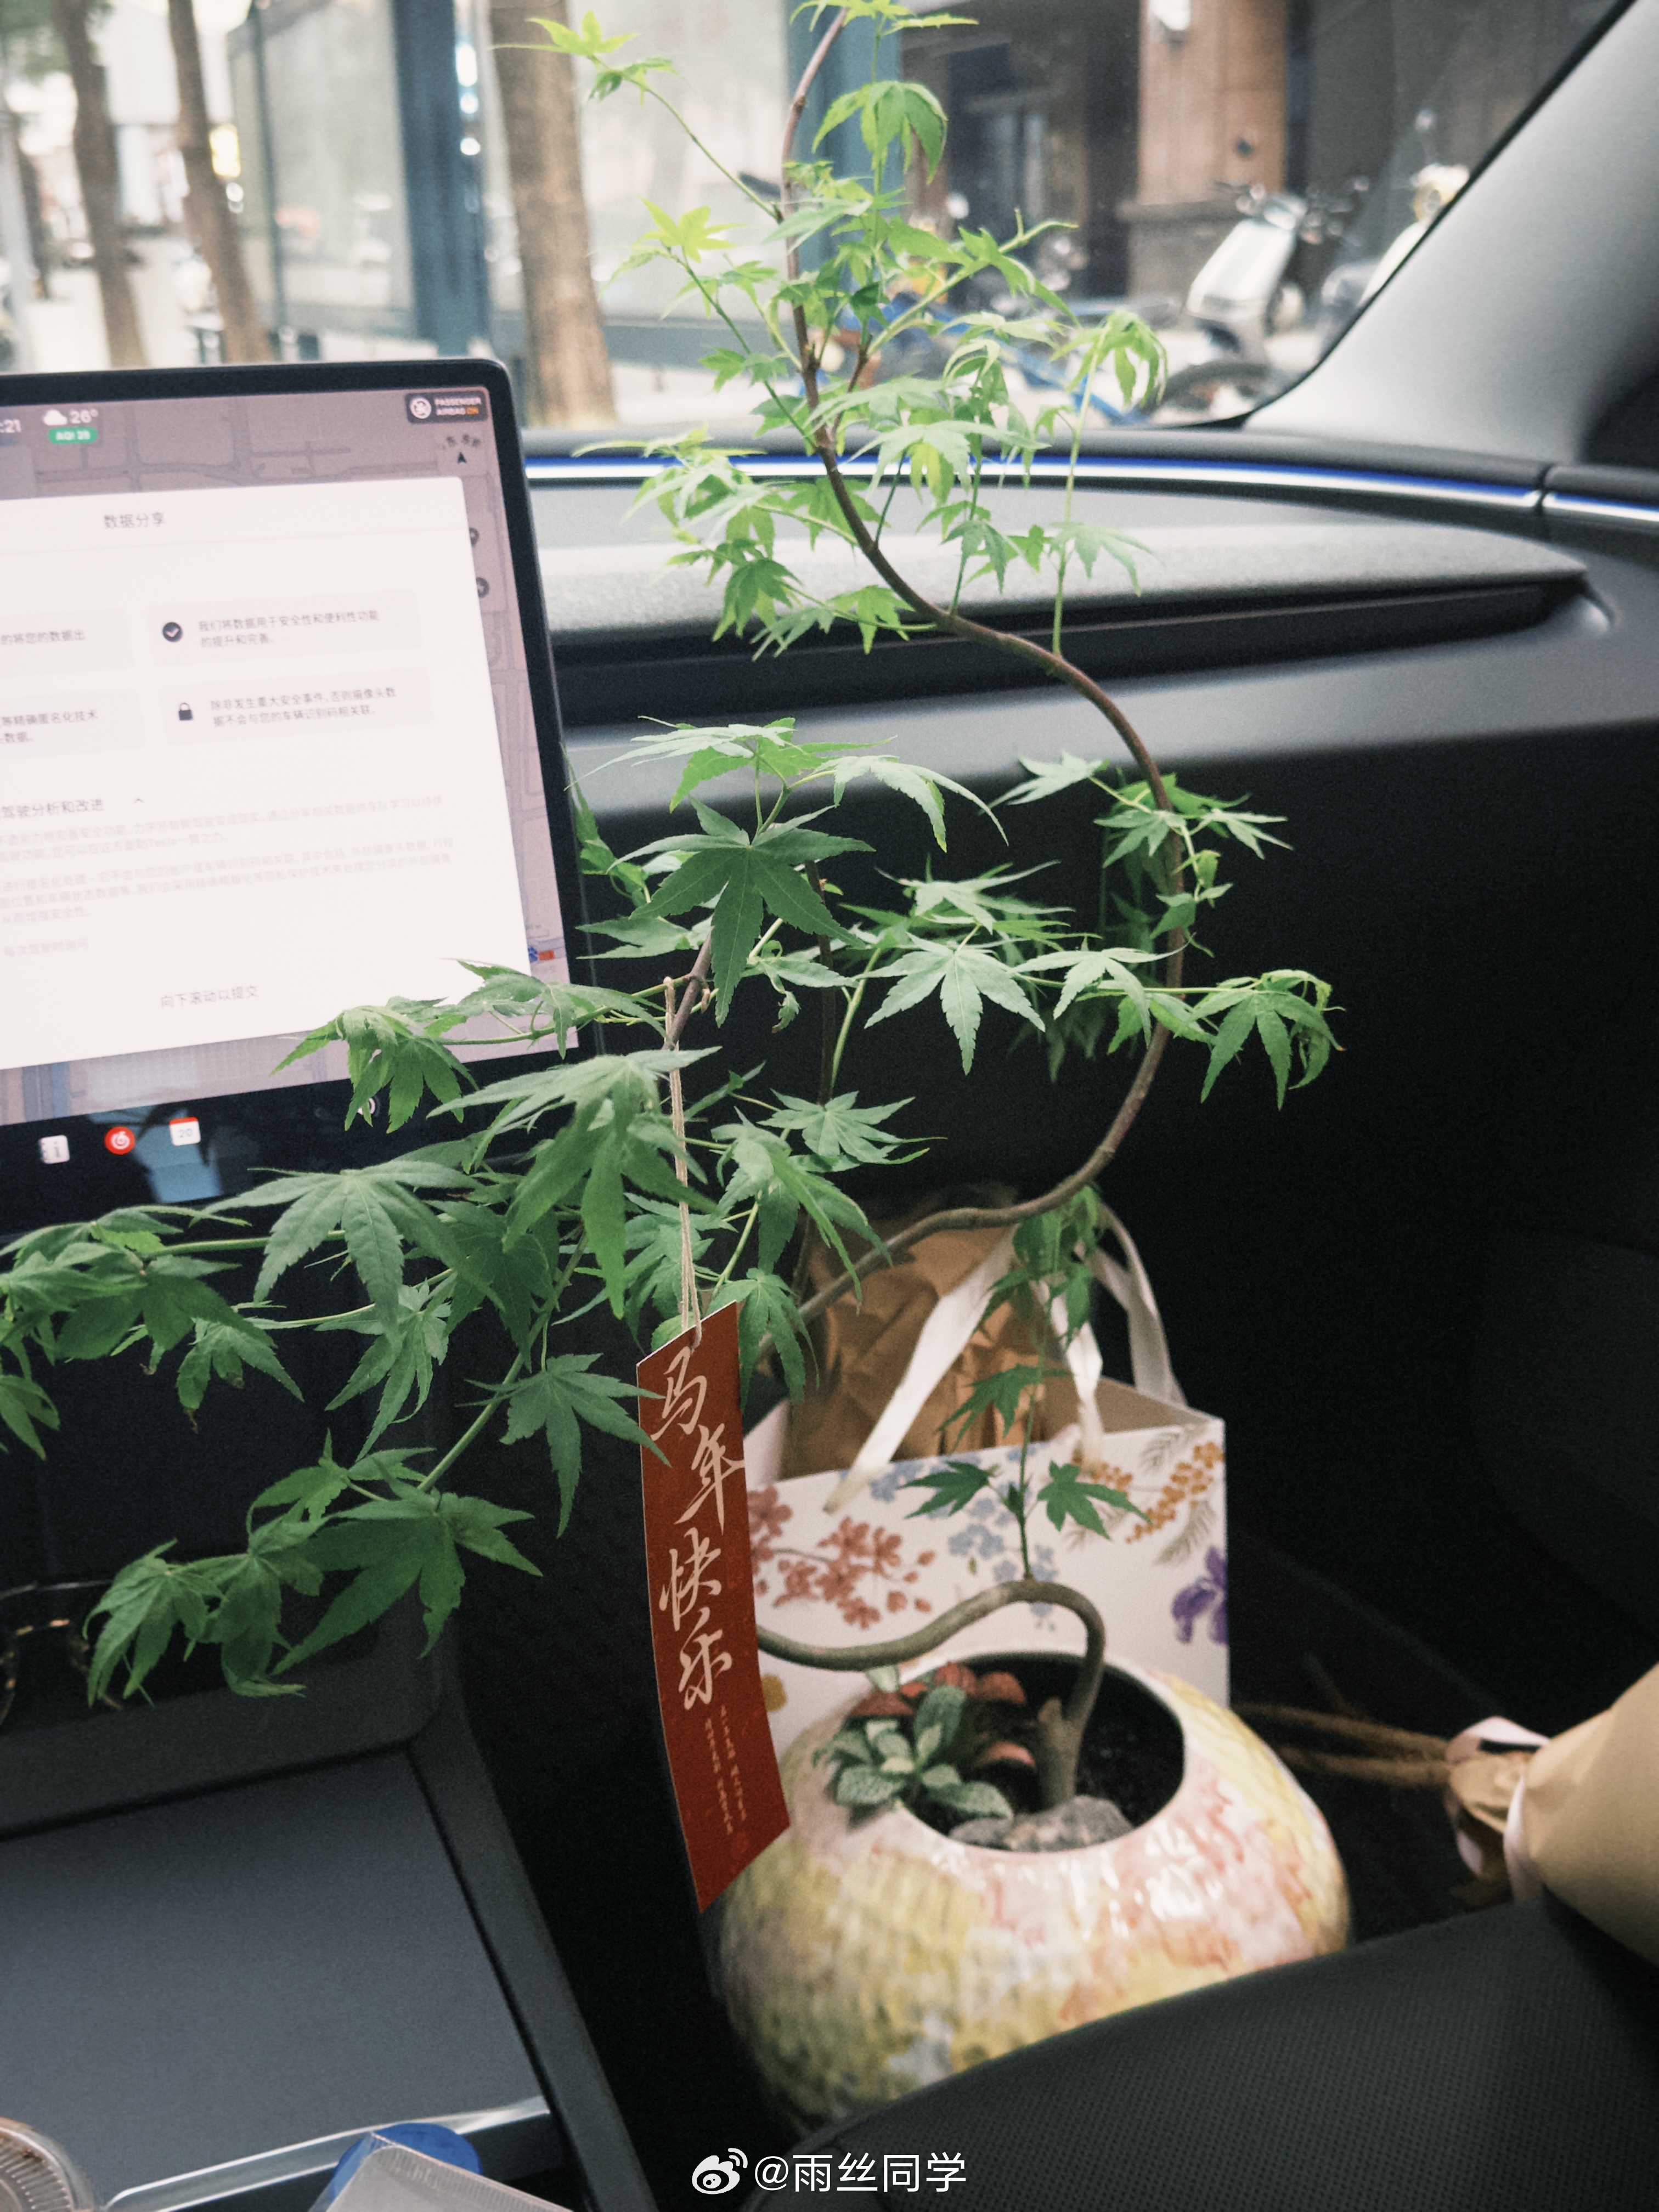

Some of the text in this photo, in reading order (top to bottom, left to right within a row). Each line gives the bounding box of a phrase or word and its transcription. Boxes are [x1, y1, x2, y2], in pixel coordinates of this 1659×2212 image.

[70, 409, 98, 423] 26°
[104, 511, 166, 529] 数据分享
[199, 610, 379, 632] 我们将数据用于安全性和便利性功能
[1, 799, 104, 818] 驾驶分析和改进
[160, 985, 259, 1009] 向下滚动以提交
[178, 1127, 193, 1139] 20
[650, 1346, 745, 1711] 马年快乐
